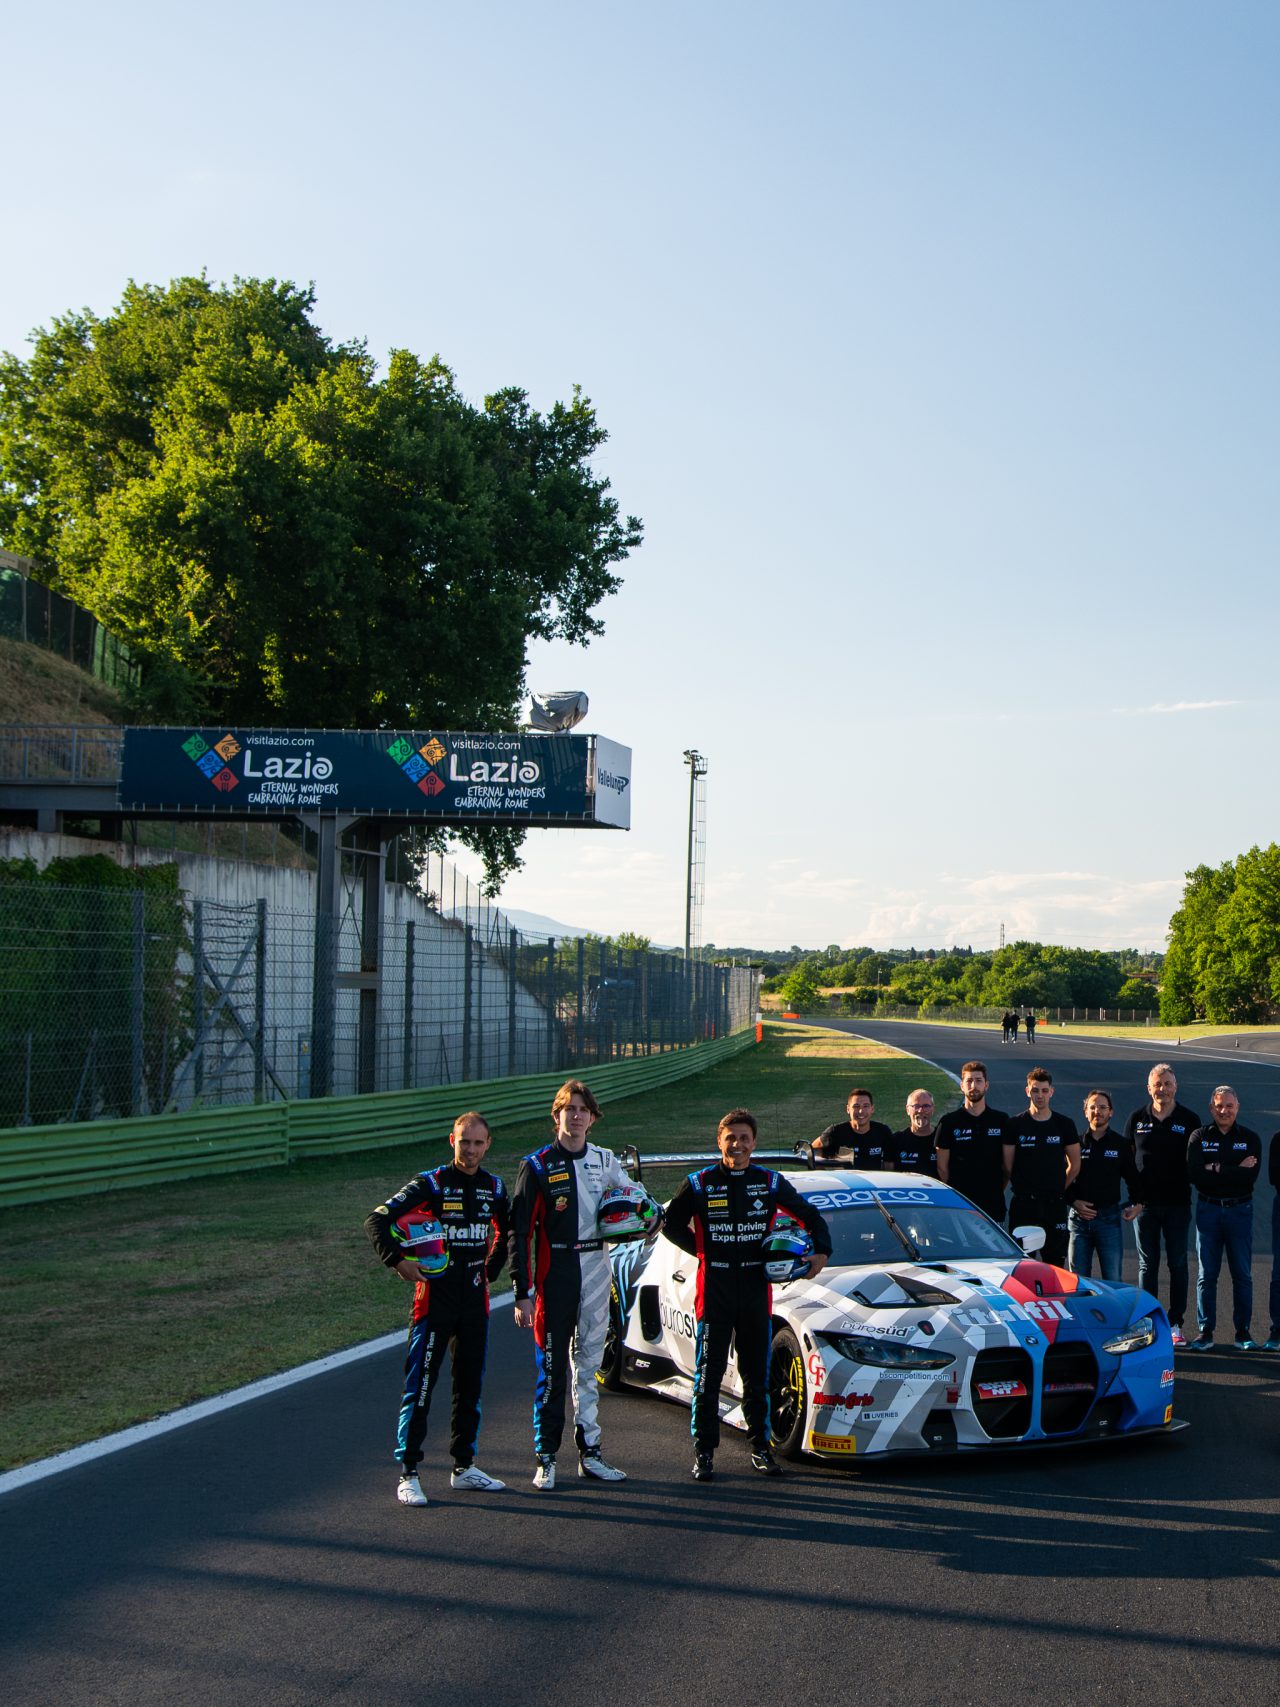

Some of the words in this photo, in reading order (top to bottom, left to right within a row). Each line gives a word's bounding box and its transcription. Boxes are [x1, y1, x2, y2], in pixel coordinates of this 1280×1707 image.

[246, 735, 315, 746] visitlazio.com
[452, 738, 521, 750] visitlazio.com
[243, 749, 334, 780] Lazio
[449, 753, 540, 783] Lazio
[261, 782, 298, 794] ETERNAL
[300, 783, 339, 795] WONDERS
[468, 786, 506, 798] ETERNAL
[507, 787, 546, 798] WONDERS
[248, 793, 295, 805] EMBRACING
[298, 794, 322, 804] ROME
[454, 798, 502, 809] EMBRACING
[504, 799, 529, 809] ROME
[807, 1189, 931, 1208] sparco
[708, 1223, 734, 1232] BMW
[737, 1222, 767, 1232] Driving
[712, 1232, 763, 1242] Experience
[952, 1300, 1076, 1325] italfil
[841, 1320, 909, 1337] bürosüd
[879, 1371, 950, 1382] bscompetition.com
[812, 1436, 850, 1450] PIRELLI
